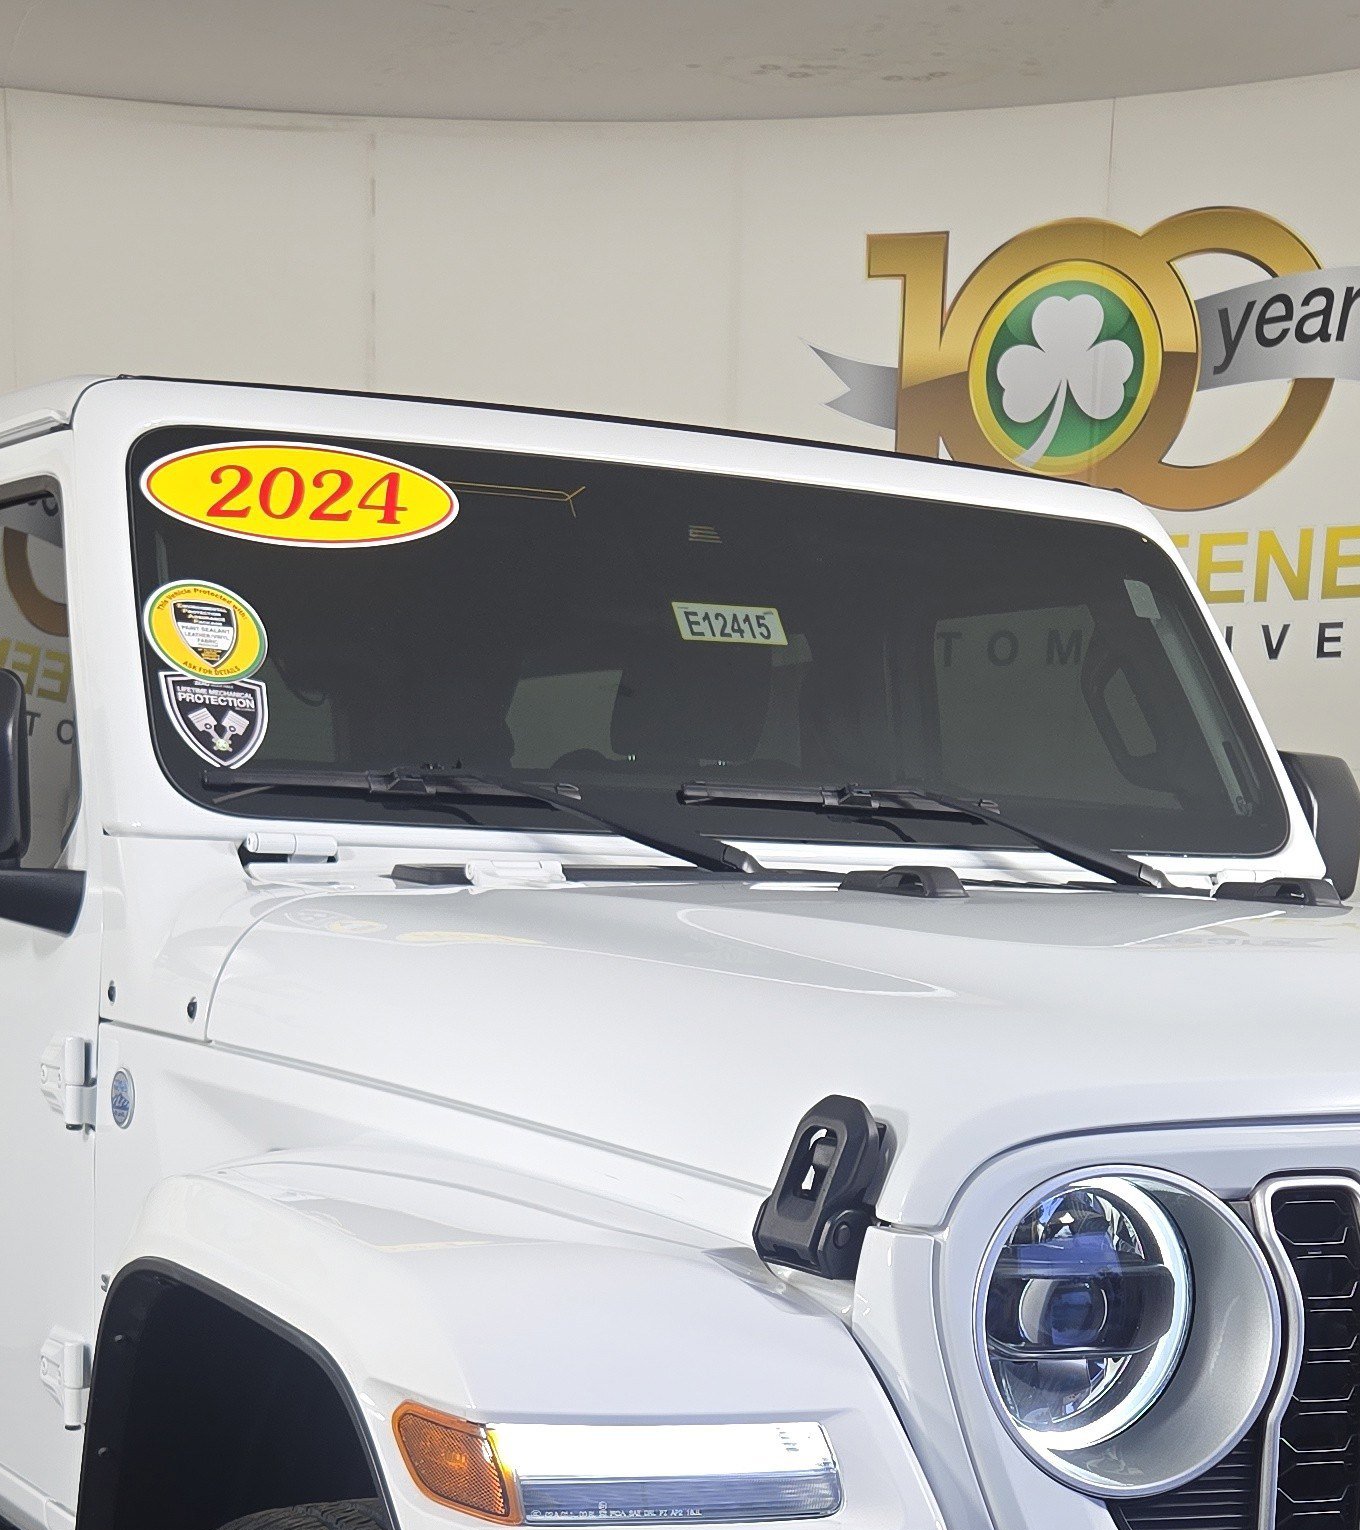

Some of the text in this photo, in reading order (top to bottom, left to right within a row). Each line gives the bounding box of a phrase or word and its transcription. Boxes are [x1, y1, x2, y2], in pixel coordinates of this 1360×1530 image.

[866, 205, 1335, 512] 100
[206, 464, 408, 525] 2024
[193, 587, 232, 604] Protected
[683, 610, 772, 640] E12415
[182, 660, 241, 676] ASK FOR DETAILS
[176, 685, 253, 700] LIFETIME MECHANICAL
[177, 692, 255, 709] PROTECTION
